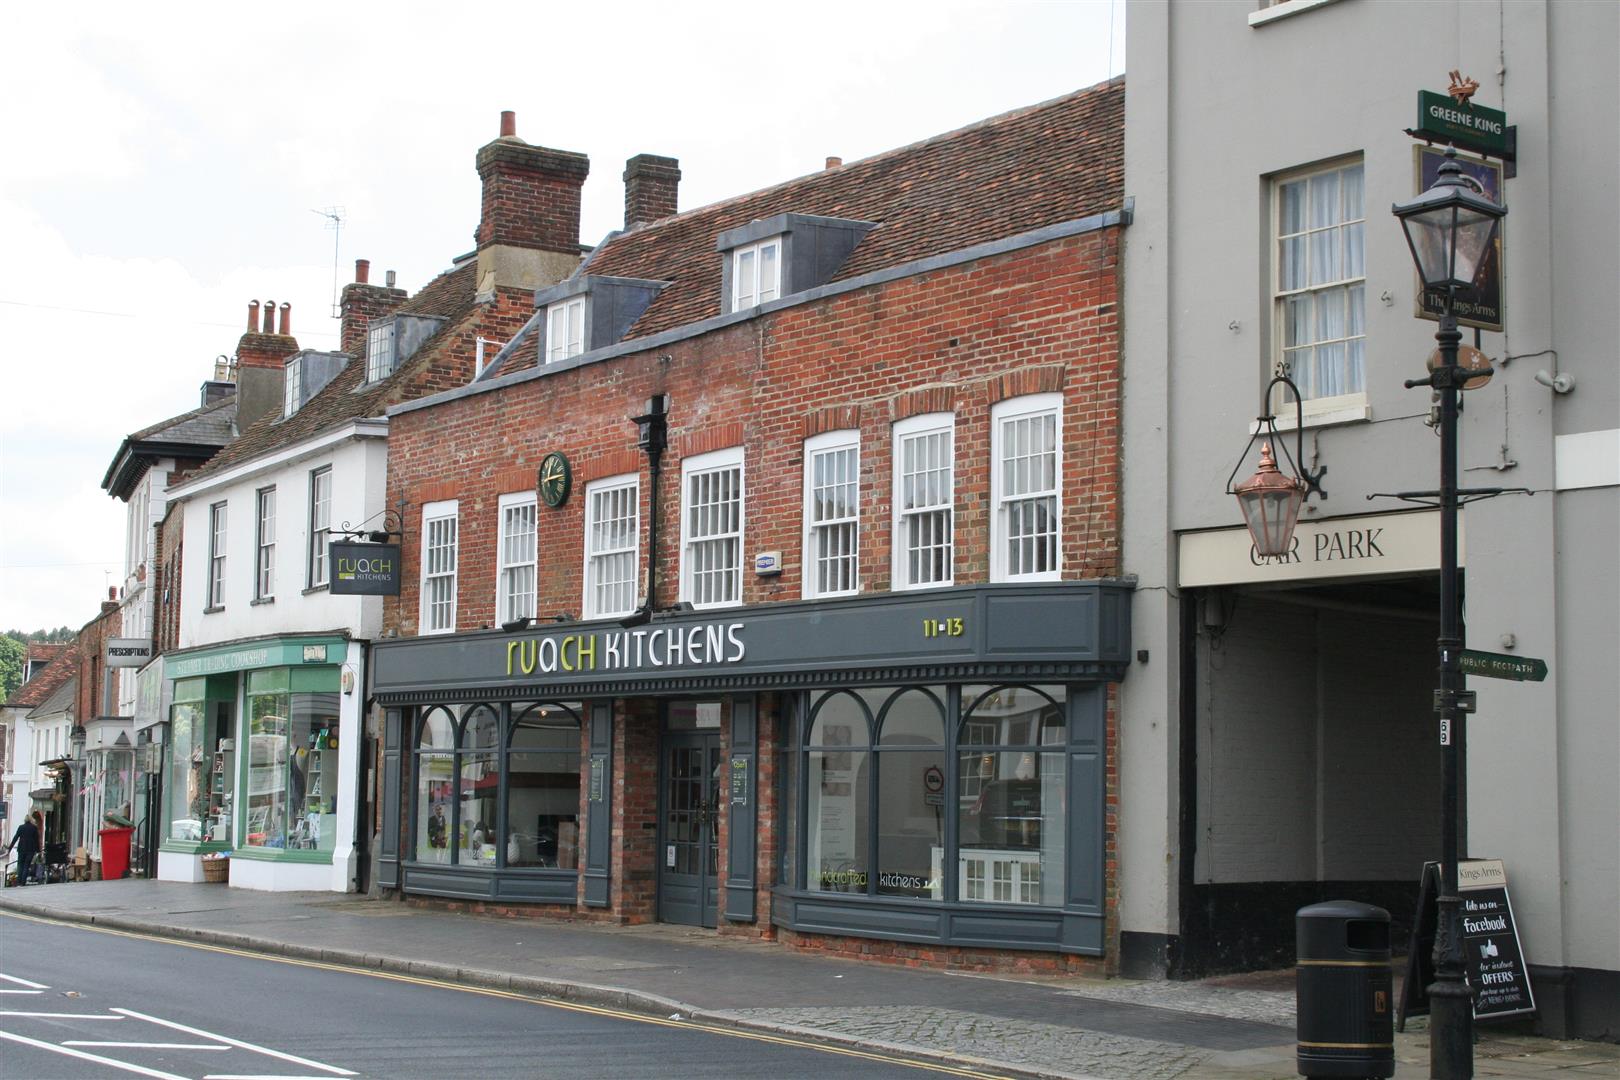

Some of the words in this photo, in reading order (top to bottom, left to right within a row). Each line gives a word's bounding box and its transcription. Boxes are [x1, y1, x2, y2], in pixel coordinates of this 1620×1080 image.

[1429, 105, 1472, 127] GREENE
[1474, 117, 1502, 135] KING
[1472, 302, 1496, 317] Arms
[1313, 528, 1385, 562] PARK
[357, 573, 391, 581] KITCHENS
[108, 647, 150, 657] PRESCRIPTIONS
[605, 623, 746, 669] KITCHENS
[1459, 656, 1486, 668] PUBLIC
[1492, 661, 1533, 673] FOOTPATH
[879, 871, 920, 889] kitchens
[1460, 869, 1480, 880] Kings
[1481, 866, 1502, 877] Arms
[1463, 915, 1507, 933] facebook
[1481, 971, 1514, 985] OFFERS
